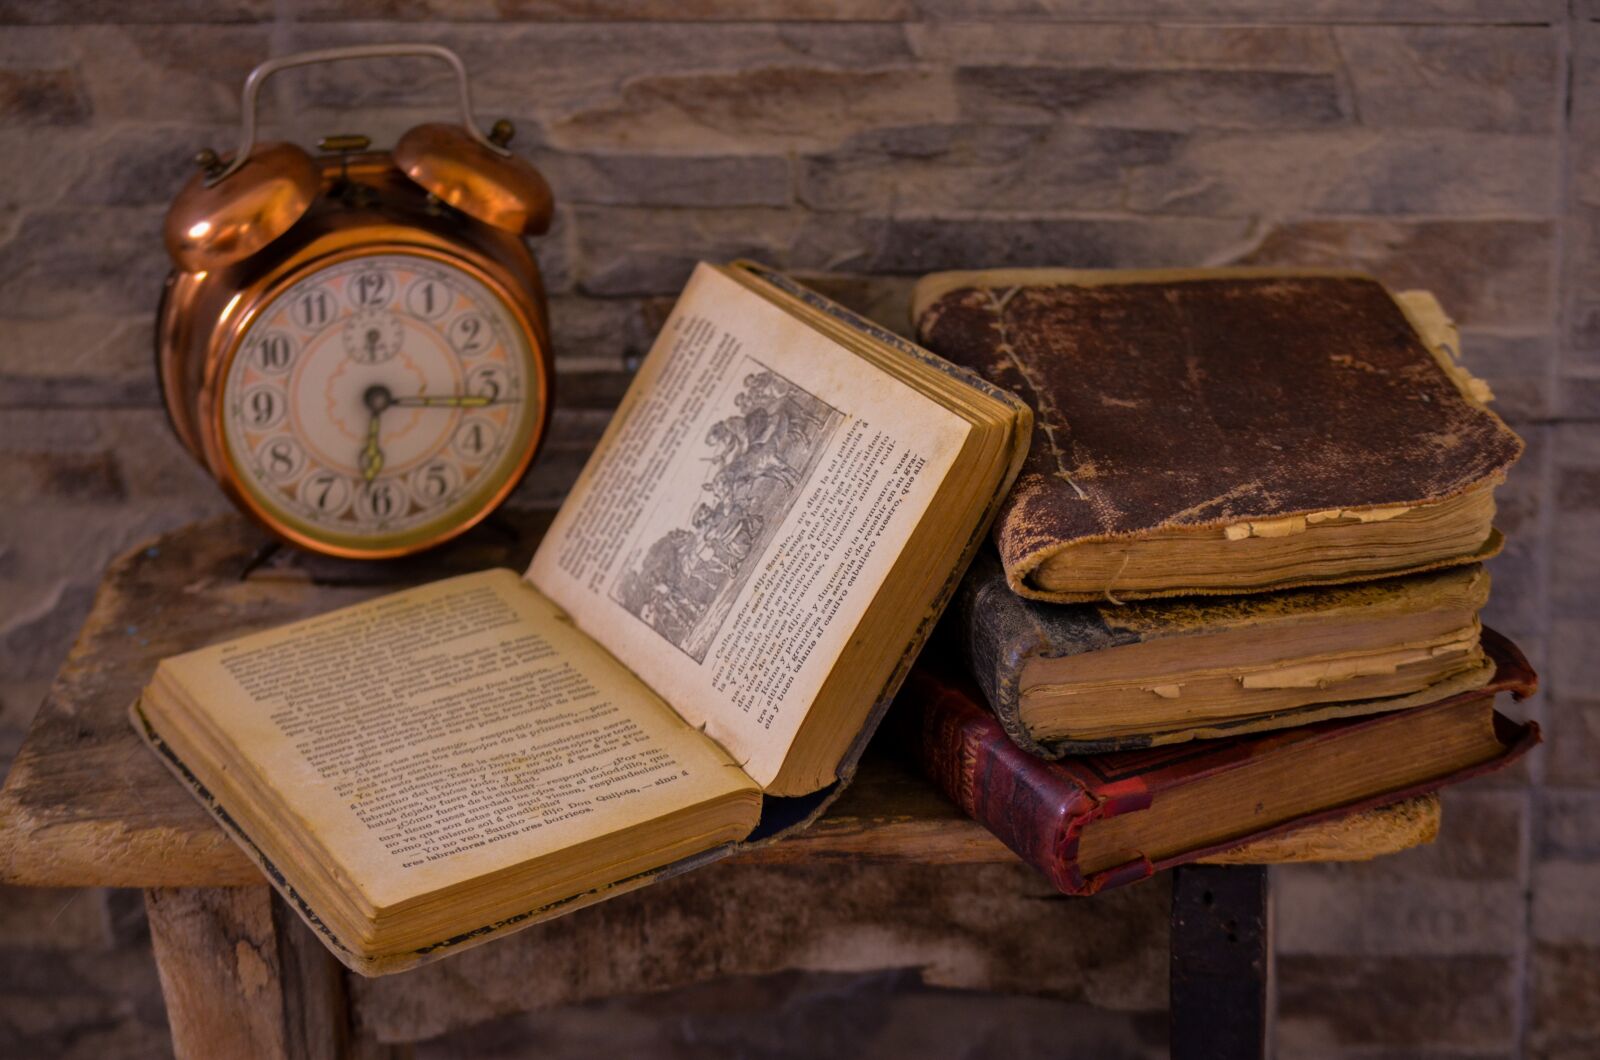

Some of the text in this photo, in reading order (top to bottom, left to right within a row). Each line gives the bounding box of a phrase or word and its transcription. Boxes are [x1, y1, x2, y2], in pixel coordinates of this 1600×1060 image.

[356, 273, 384, 304] 12
[421, 282, 432, 313] 1
[303, 294, 326, 325] 11
[461, 317, 480, 349] 2
[261, 338, 290, 368] 10
[252, 391, 272, 422] 9
[463, 424, 482, 452] 4
[269, 443, 293, 475] 8
[806, 487, 822, 508] diga
[819, 475, 829, 484] la
[827, 458, 837, 472] tal
[836, 418, 862, 458] palabra,
[317, 477, 333, 509] 7
[426, 466, 447, 500] 5
[371, 487, 391, 517] 6
[777, 600, 788, 617] del
[787, 573, 806, 600] rucio
[804, 550, 821, 572] tuvo
[821, 532, 833, 548] del
[832, 489, 857, 531] cabestro
[856, 477, 864, 488] al
[862, 435, 889, 478] jumento
[711, 665, 724, 687] sino
[723, 616, 751, 663] despabile
[750, 592, 765, 614] esos
[764, 569, 779, 590] ojos
[784, 528, 806, 557] venga
[809, 488, 829, 517] hacer
[830, 432, 863, 485] reverencia
[737, 631, 762, 675] diciendo
[761, 608, 774, 629] esto
[774, 595, 782, 606] se
[811, 507, 837, 541] recibir
[838, 482, 852, 497] las
[862, 430, 882, 461] aldea-
[785, 611, 813, 654] princesa
[817, 561, 845, 601] duquesa
[843, 546, 852, 560] de
[850, 535, 859, 545] la
[856, 478, 894, 534] hermosura,
[892, 448, 910, 474] vues-
[716, 682, 726, 693] la
[725, 645, 745, 680] señora
[744, 630, 753, 643] de
[752, 612, 763, 628] sus
[762, 543, 807, 611] pensamientos,
[806, 521, 820, 540] que
[819, 507, 829, 520] ya
[827, 480, 845, 504] llega
[737, 694, 746, 707] de
[743, 673, 758, 692] una
[754, 658, 766, 671] de
[765, 641, 776, 655] las
[786, 563, 825, 616] labradoras,
[827, 505, 858, 551] hincando
[858, 469, 879, 501] ambas
[879, 439, 896, 465] rodi-
[756, 708, 767, 724] tra
[766, 672, 786, 706] altivez
[791, 616, 821, 661] grandeza
[820, 598, 833, 614] sea
[831, 559, 855, 596] servida
[854, 543, 864, 556] de
[886, 489, 896, 502] en
[894, 476, 904, 488] su
[903, 453, 917, 476] gra-
[764, 713, 774, 730] cia
[776, 675, 794, 701] buen
[792, 639, 816, 673] talante
[815, 625, 824, 638] al
[823, 589, 848, 626] cautivo
[847, 540, 876, 586] caballero
[875, 498, 902, 536] vuestro,
[900, 472, 914, 495] que
[909, 456, 926, 475] allí
[742, 694, 755, 713] llas
[754, 679, 763, 692] en
[762, 666, 770, 677] el
[769, 636, 788, 665] suelo,
